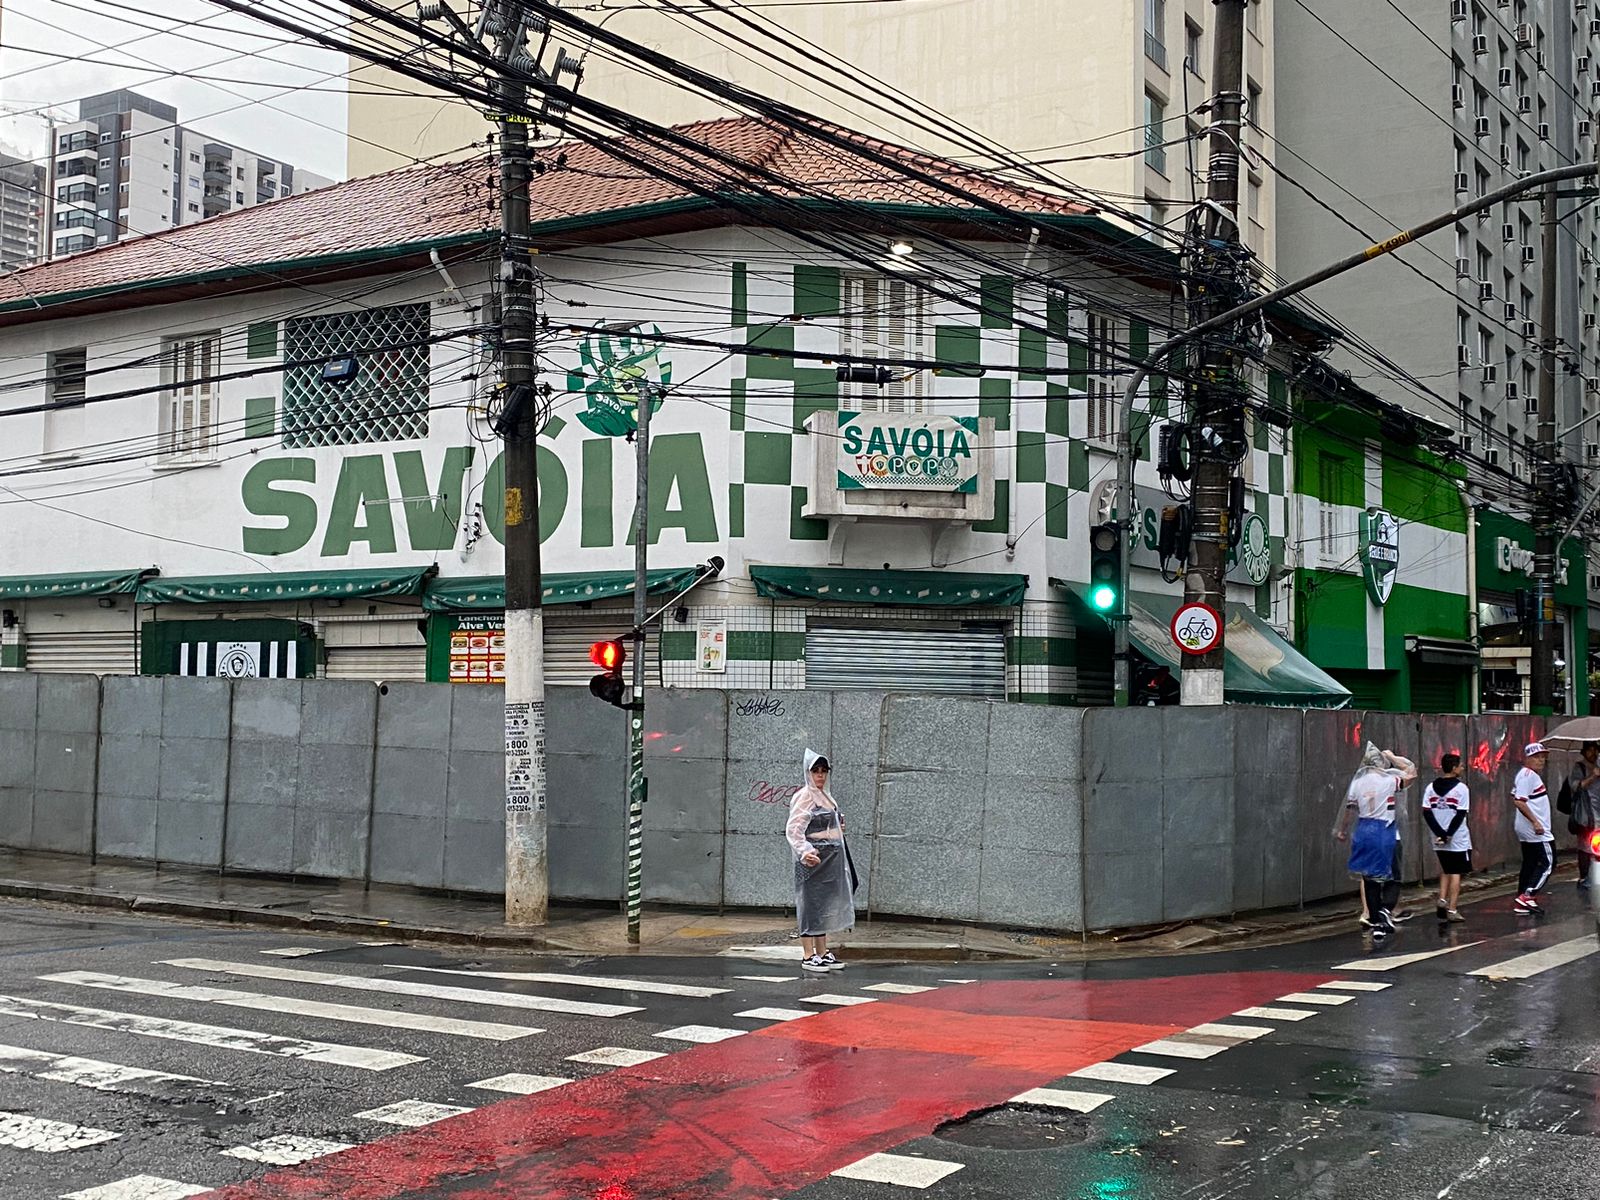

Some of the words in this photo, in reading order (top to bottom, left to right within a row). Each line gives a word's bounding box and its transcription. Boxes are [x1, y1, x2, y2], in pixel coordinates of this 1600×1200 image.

[842, 423, 971, 459] SAVÓIA
[241, 415, 719, 556] SAVÓIA
[511, 740, 528, 749] 800
[512, 795, 529, 804] 800
